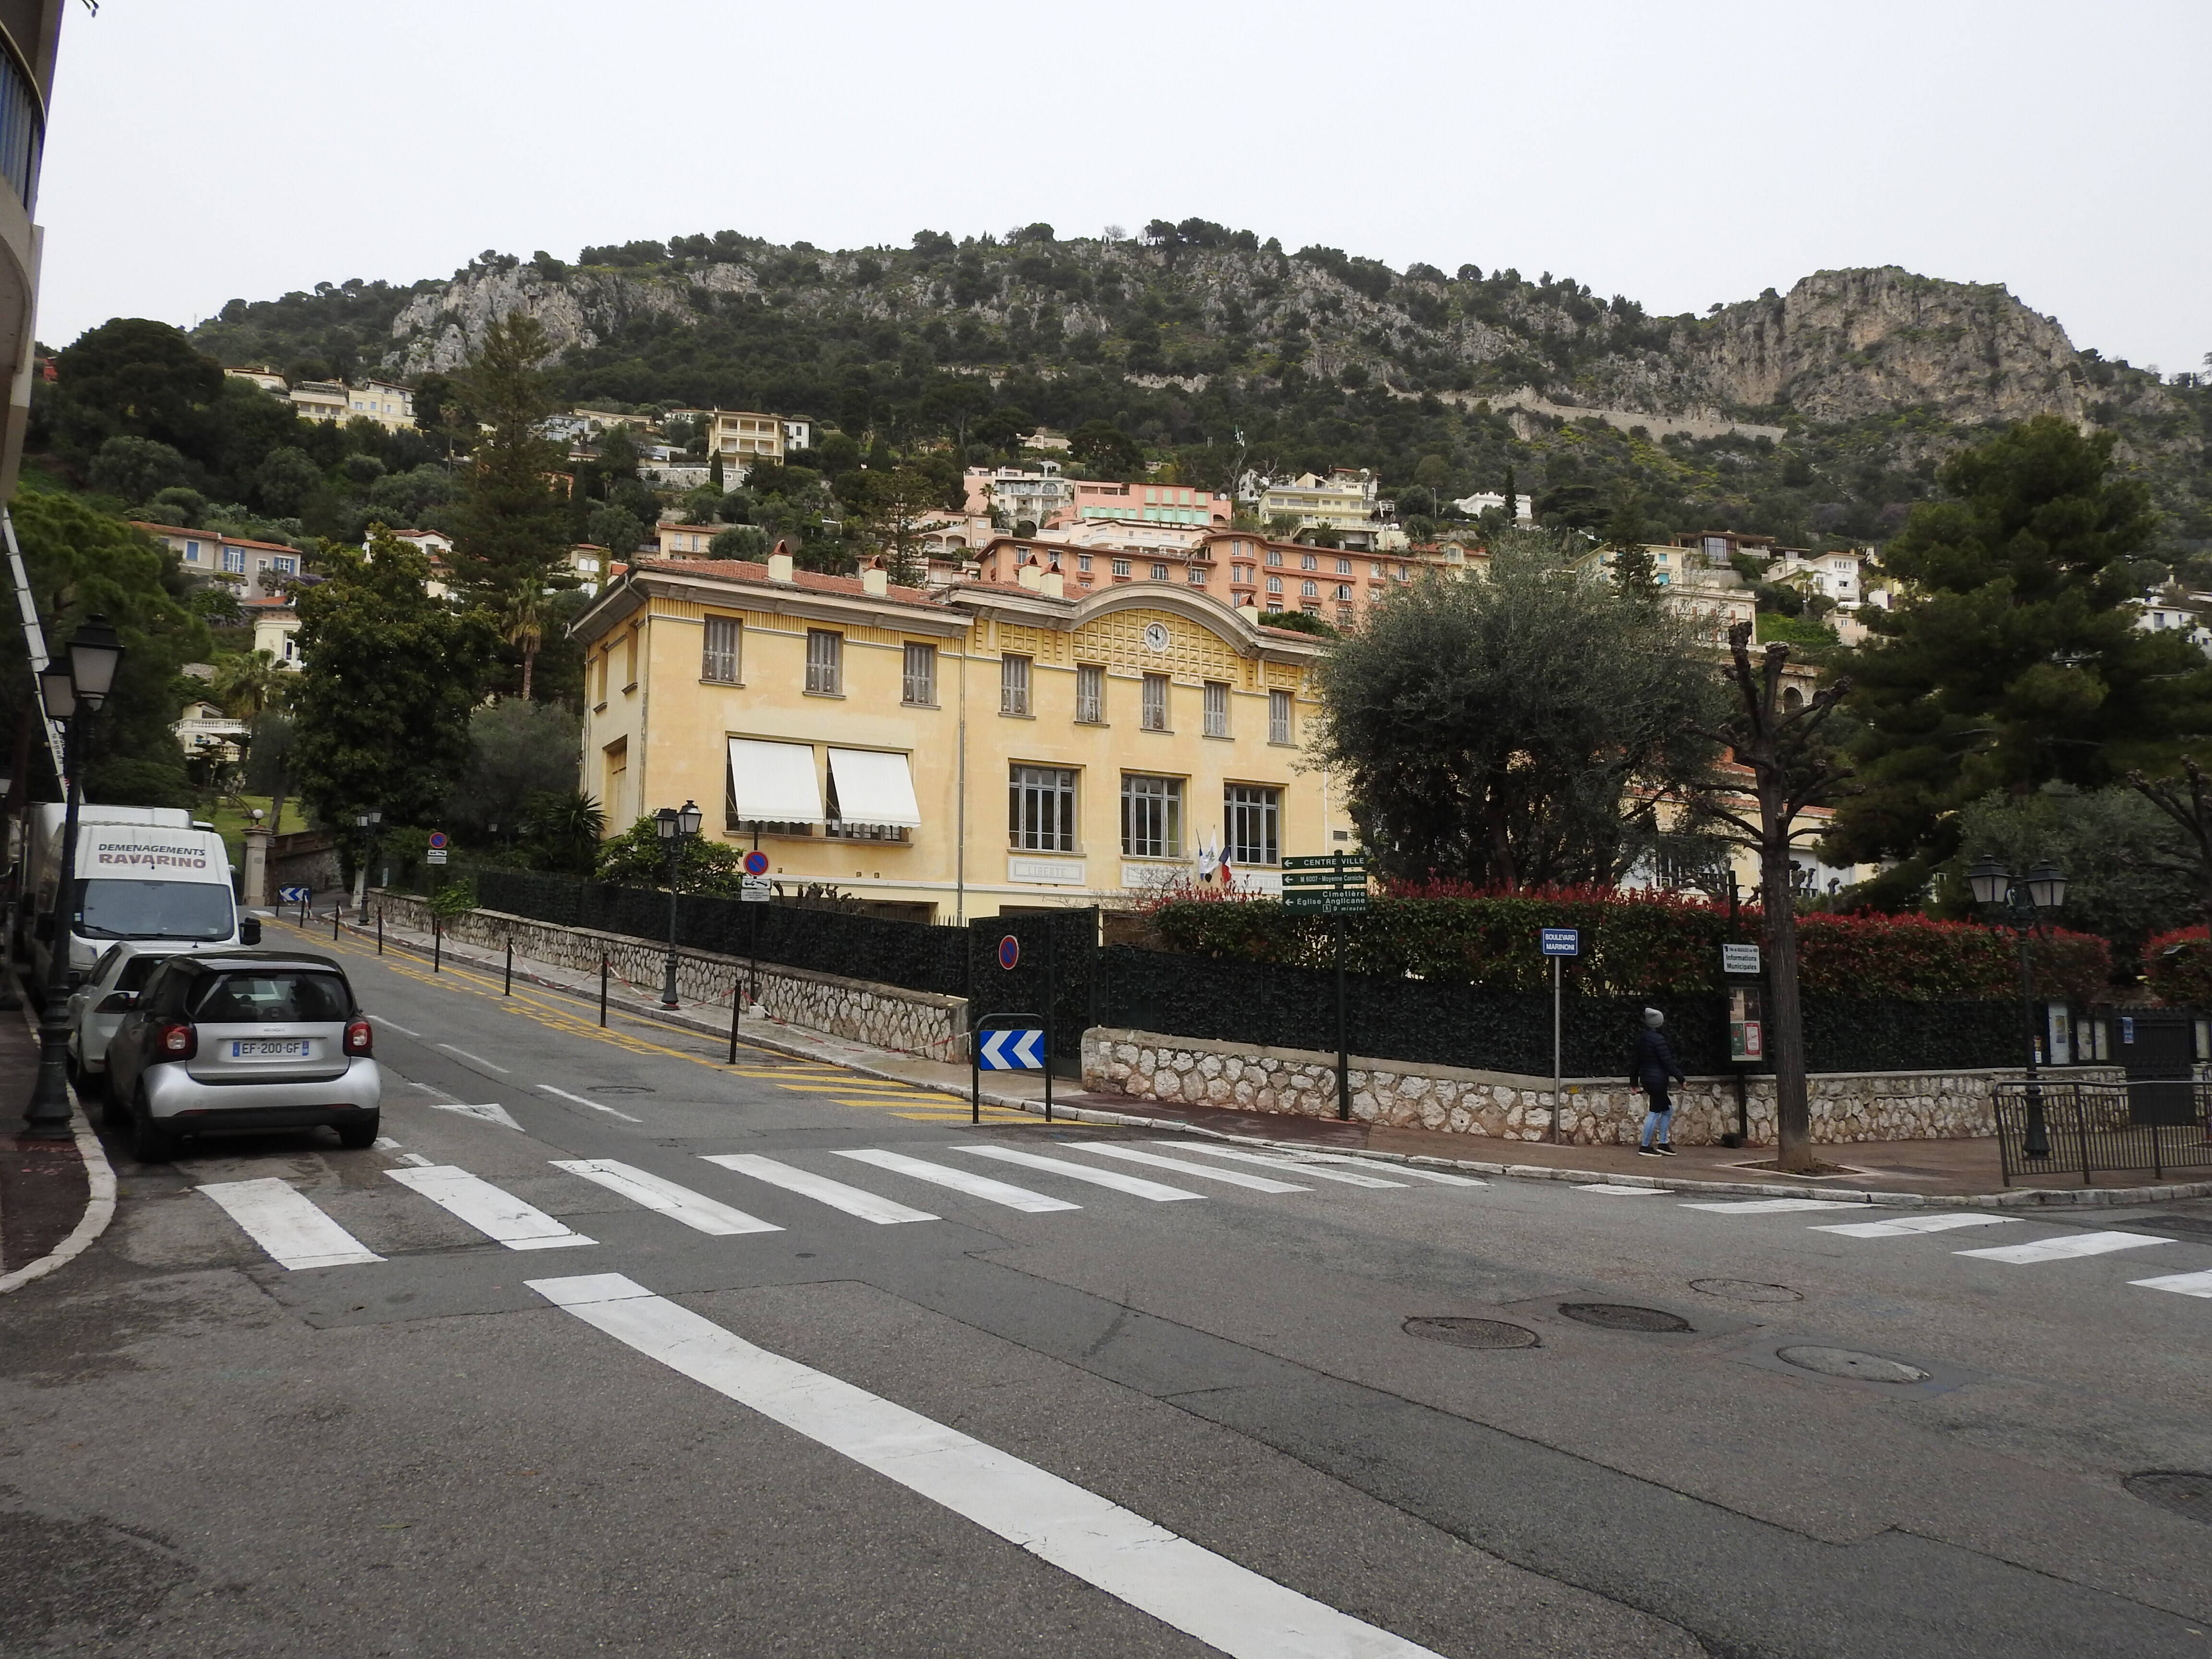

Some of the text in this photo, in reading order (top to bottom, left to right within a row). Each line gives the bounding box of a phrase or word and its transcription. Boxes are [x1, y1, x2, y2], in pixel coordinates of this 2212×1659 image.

[98, 844, 205, 856] DEMENAGEMENTS
[99, 854, 206, 868] RAVARINO
[1297, 898, 1322, 906] Église
[242, 1043, 300, 1054] EF-200-GF
